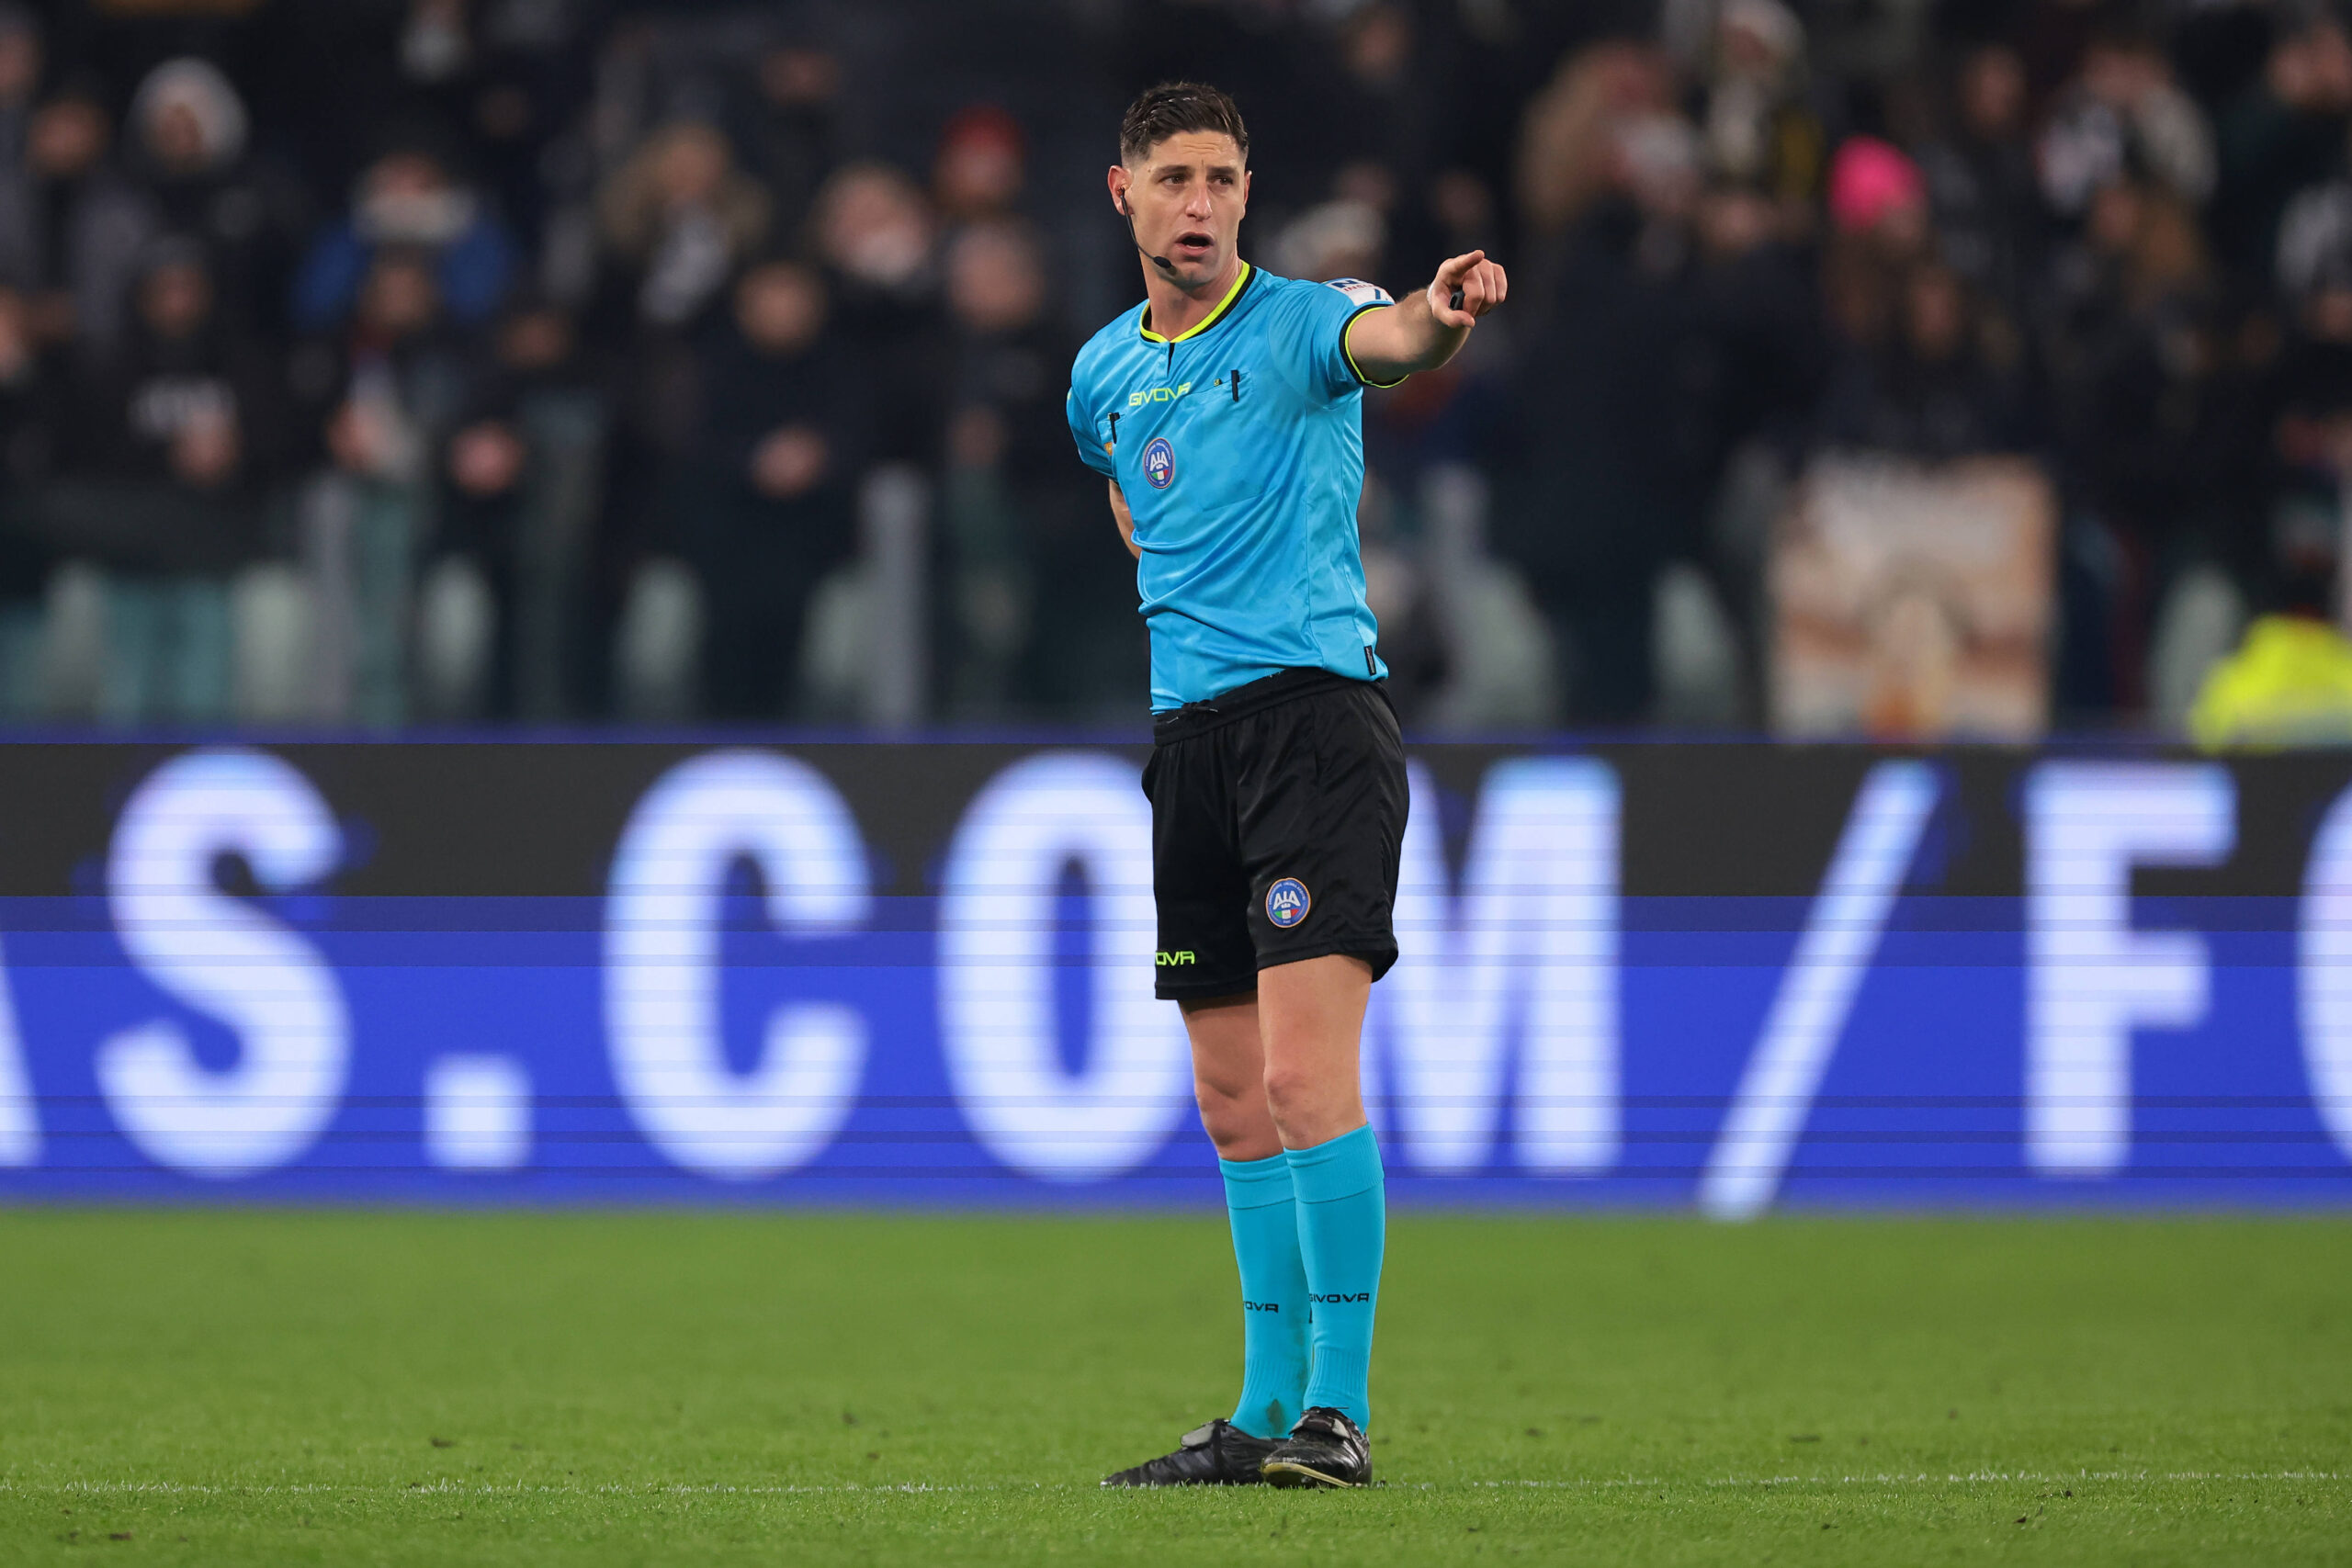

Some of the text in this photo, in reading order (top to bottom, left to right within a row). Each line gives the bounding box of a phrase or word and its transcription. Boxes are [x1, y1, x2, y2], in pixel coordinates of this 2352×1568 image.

[1129, 381, 1191, 406] GIVOVA
[1149, 451, 1170, 472] AIA
[1272, 890, 1302, 910] AIA
[0, 746, 2352, 1220] S.COM/F
[1243, 1301, 1279, 1314] OVA
